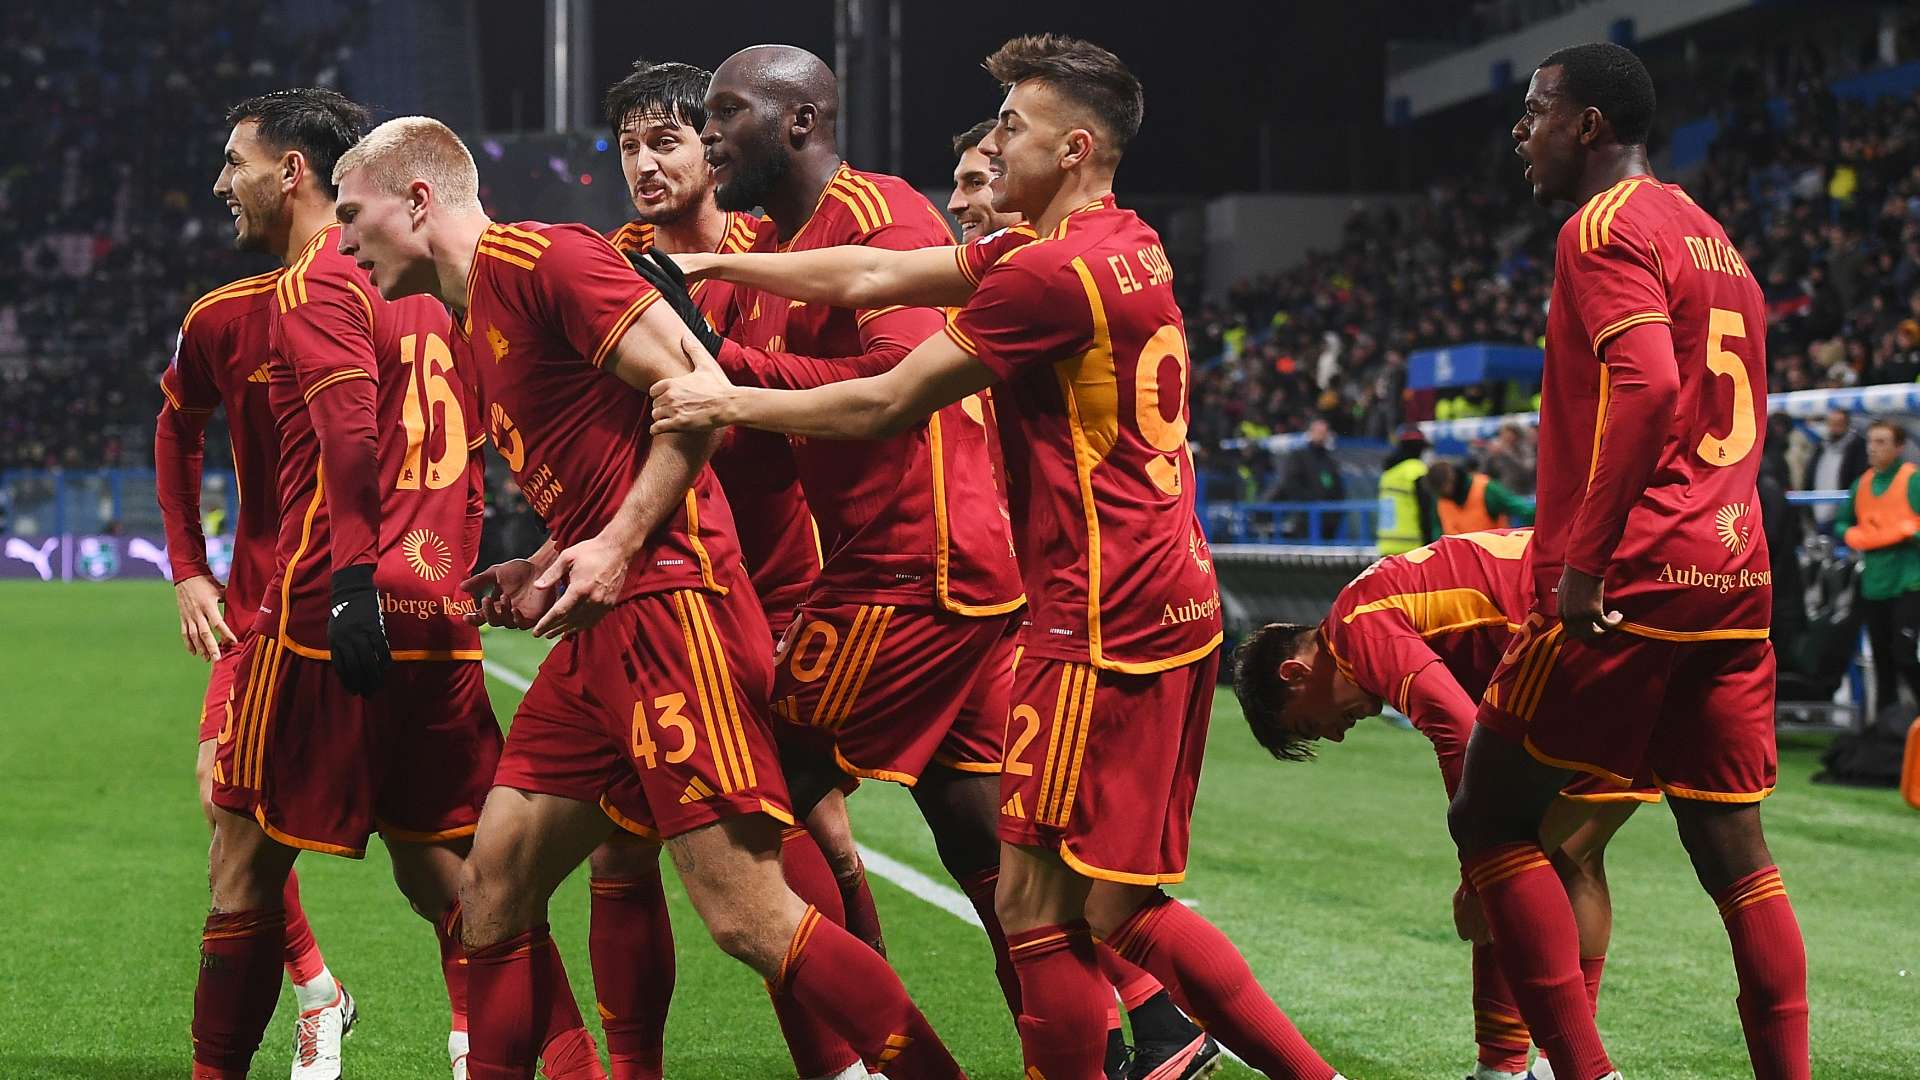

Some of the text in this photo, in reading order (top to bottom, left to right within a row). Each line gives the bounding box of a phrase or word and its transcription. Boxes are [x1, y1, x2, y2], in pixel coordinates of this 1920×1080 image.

[1107, 254, 1143, 294] EL
[396, 333, 467, 490] 16
[1136, 325, 1188, 496] 9
[1697, 308, 1757, 467] 5
[1656, 563, 1736, 594] Auberge
[632, 692, 697, 770] 43
[1005, 704, 1040, 777] 2
